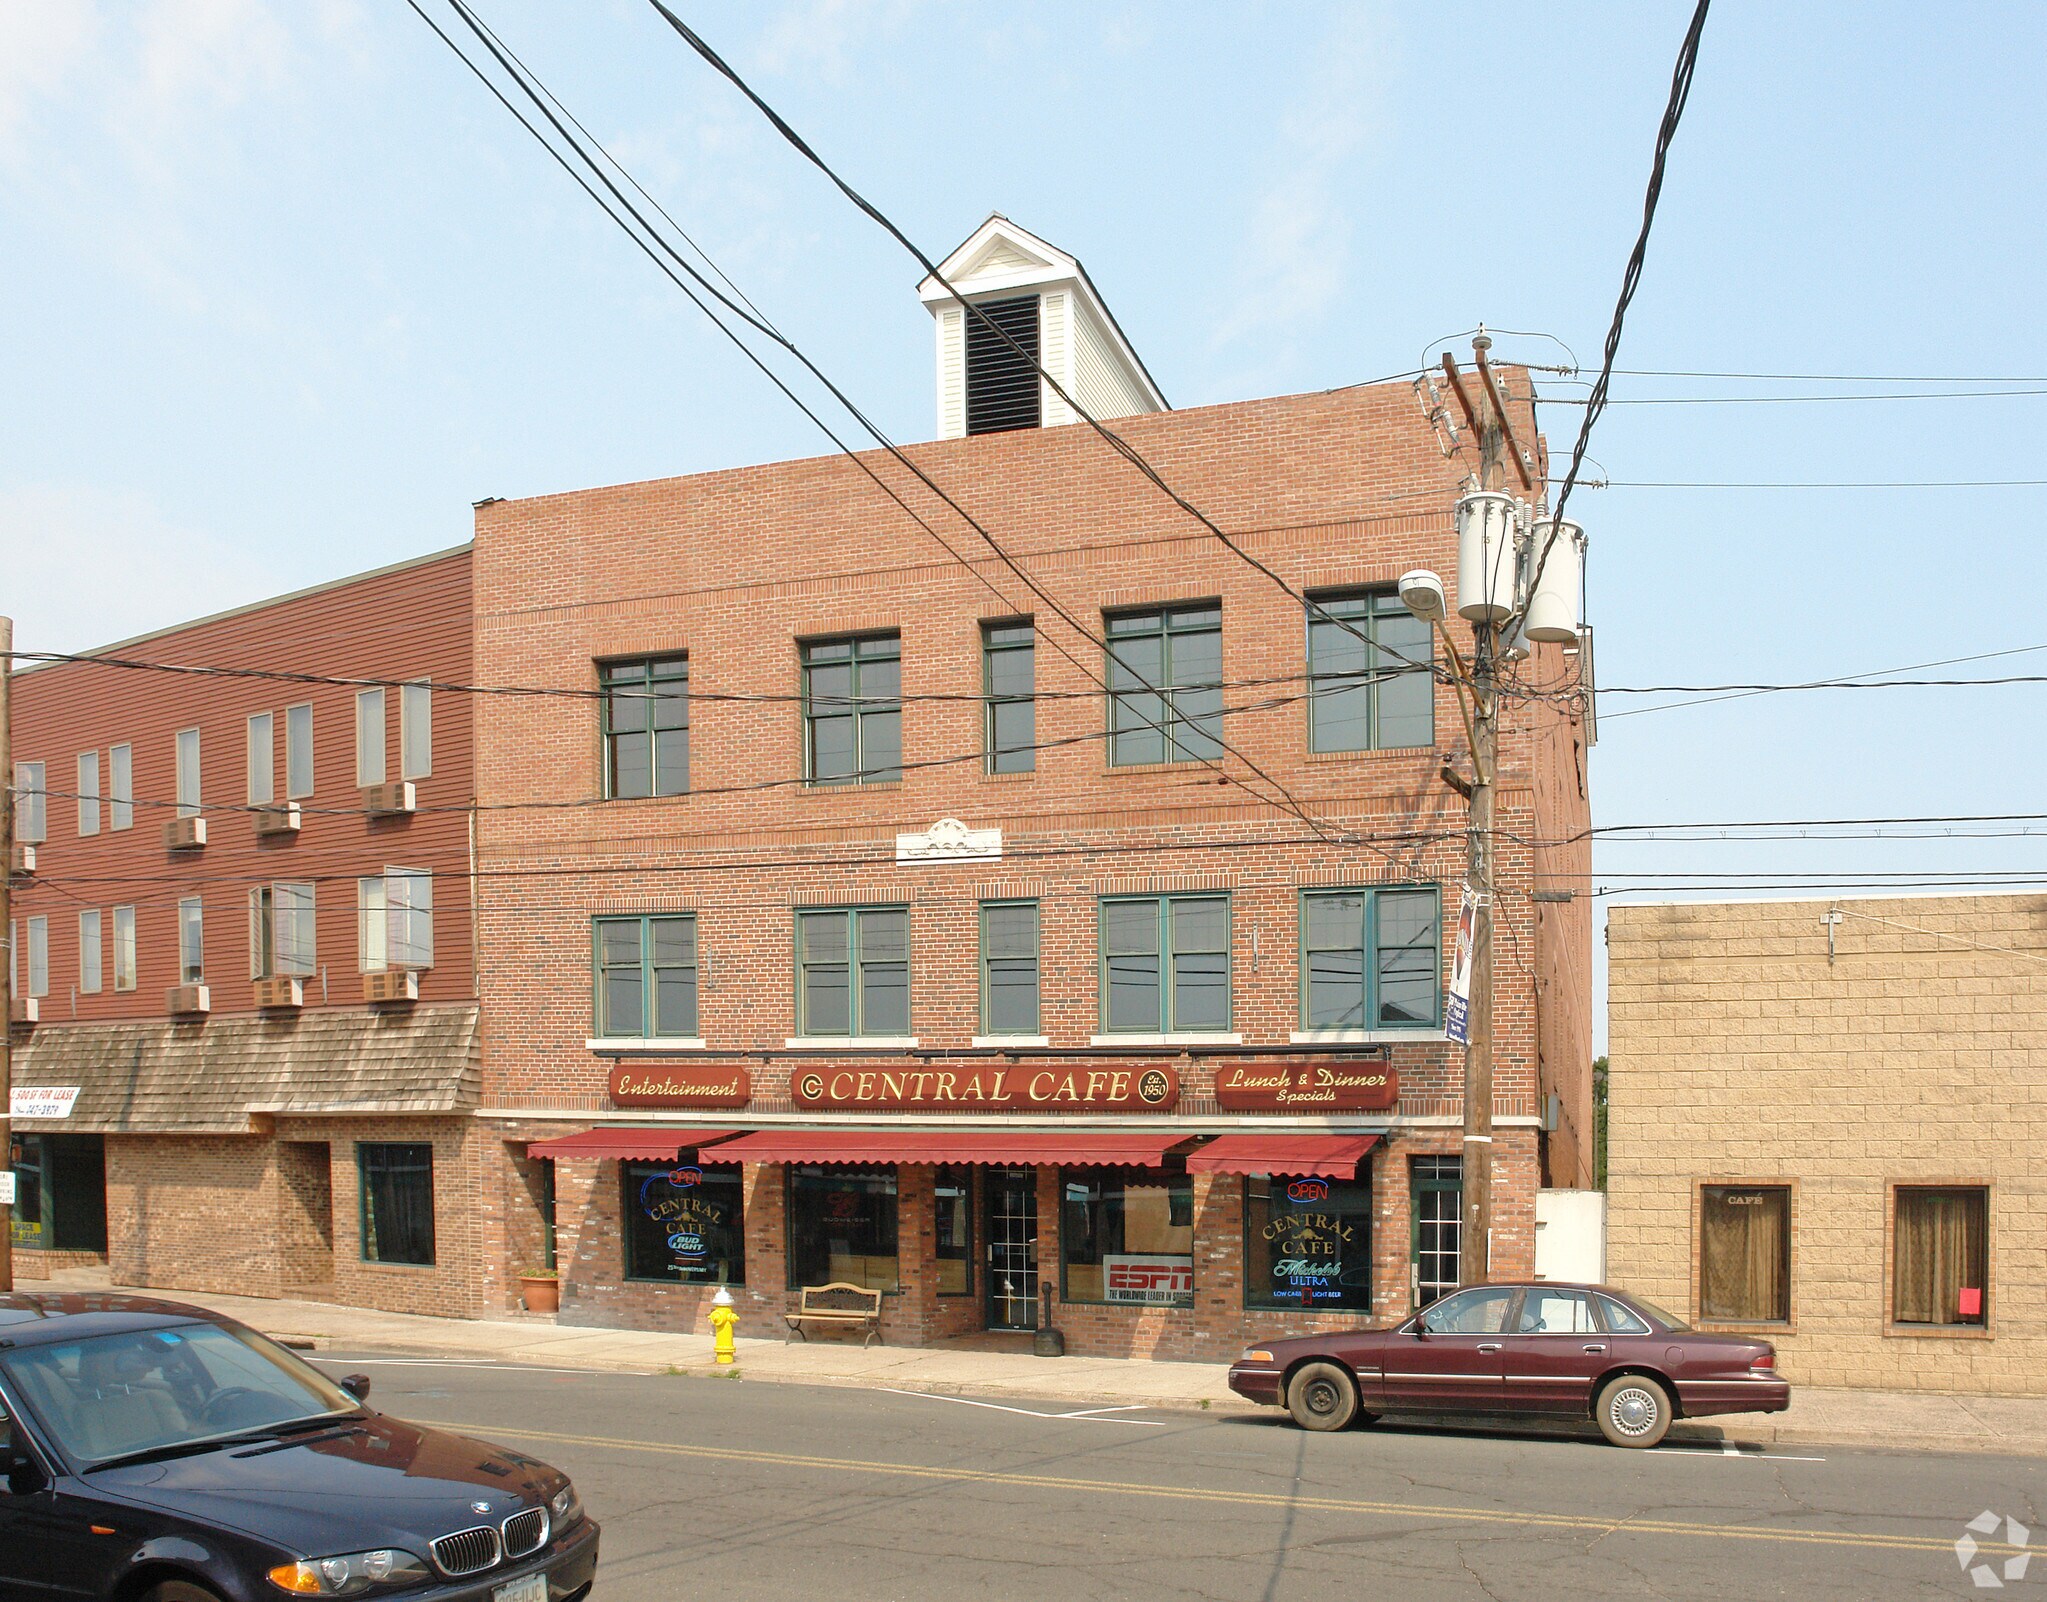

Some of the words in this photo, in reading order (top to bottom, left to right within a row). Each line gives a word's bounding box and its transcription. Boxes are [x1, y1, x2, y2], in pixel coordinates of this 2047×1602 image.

[1147, 1074, 1162, 1084] Est.
[1226, 1068, 1291, 1087] Lunch
[1298, 1073, 1308, 1085] &
[1315, 1068, 1387, 1087] Dinner
[618, 1075, 738, 1096] Entertainment
[830, 1071, 1012, 1101] CENTRAL
[1029, 1071, 1132, 1101] CAFE
[1143, 1084, 1166, 1096] 1950
[53, 1090, 75, 1100] LEASE
[1276, 1089, 1336, 1104] Specials
[669, 1170, 702, 1185] OPEN
[1288, 1182, 1328, 1200] OPEN
[1727, 1191, 1763, 1205] CAFÉ
[651, 1198, 721, 1224] CENTRAL
[666, 1222, 706, 1235] CAFE
[1262, 1213, 1355, 1242] CENTRAL
[672, 1242, 704, 1251] LIGHT
[677, 1236, 700, 1244] BUD
[1282, 1241, 1334, 1255] CAFE
[1273, 1259, 1342, 1277] Michelob
[1109, 1264, 1192, 1290] ESPN
[1290, 1276, 1329, 1287] ULTRA
[1109, 1289, 1118, 1300] THE
[1118, 1289, 1147, 1301] WORLDWIDE
[1147, 1290, 1165, 1301] LEADER
[1287, 1290, 1302, 1298] CARB
